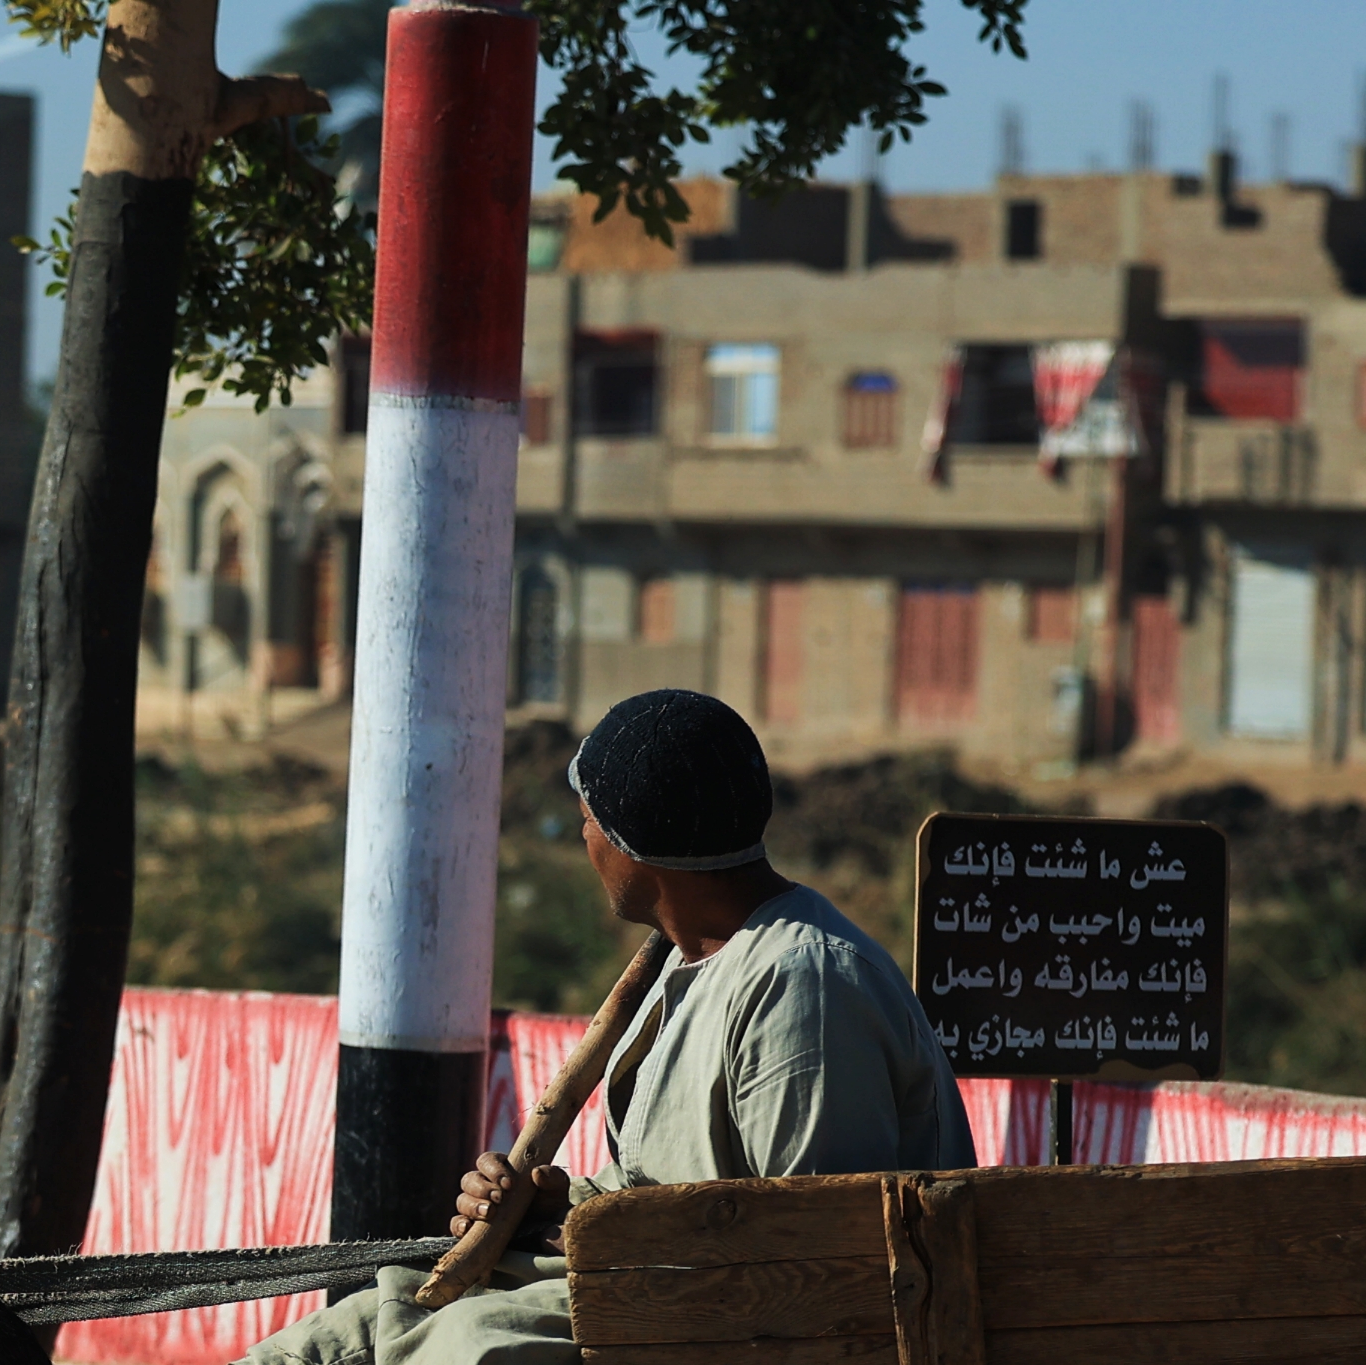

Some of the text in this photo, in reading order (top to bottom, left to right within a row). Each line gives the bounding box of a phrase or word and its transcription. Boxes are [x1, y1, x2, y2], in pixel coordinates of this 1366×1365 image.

[944, 838, 1187, 889] عش ما شئت فإنك
[1001, 904, 1040, 942] من
[1049, 907, 1141, 945] واحبب
[1150, 904, 1205, 947] ميت
[932, 954, 1207, 1002] فإنك مفارقه واعمل
[968, 1014, 1045, 1061] مجازي
[1054, 1015, 1117, 1059] فإنك
[1125, 1012, 1180, 1051] شئت
[1190, 1022, 1209, 1051] ما
